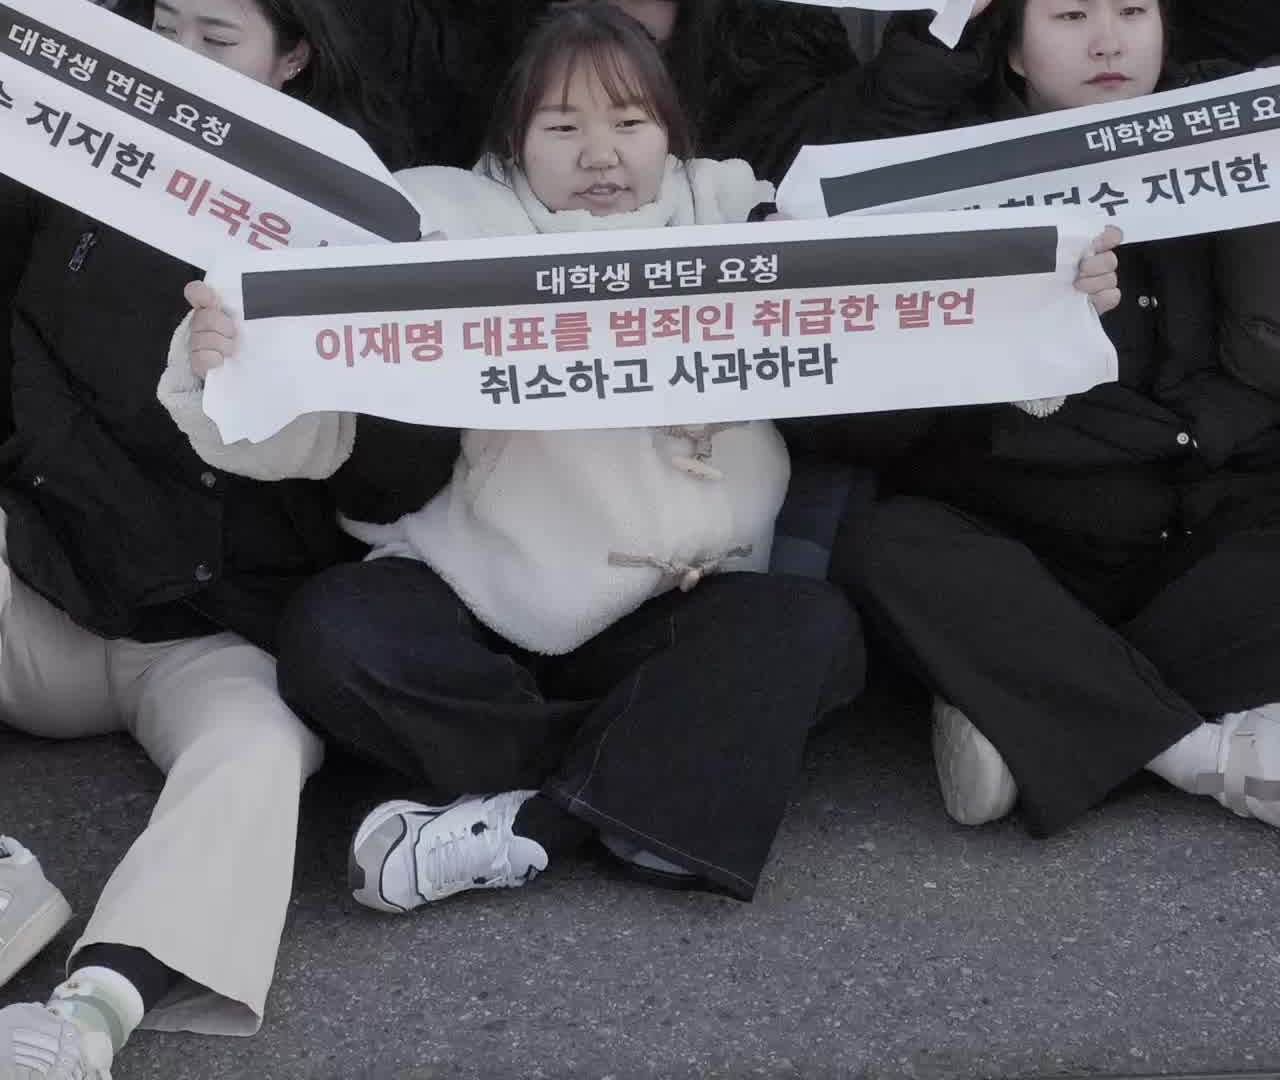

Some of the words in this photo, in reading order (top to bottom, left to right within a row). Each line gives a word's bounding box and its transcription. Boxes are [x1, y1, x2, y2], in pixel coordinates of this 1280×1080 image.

[7, 23, 100, 79] 대학생
[104, 68, 165, 116] 면담
[168, 103, 231, 147] 요청
[1085, 111, 1177, 154] 대학생
[1182, 100, 1241, 141] 면담
[26, 99, 157, 190] 지지한
[165, 169, 292, 251] 미국은
[1142, 153, 1269, 208] 지지한
[534, 262, 634, 296] 대학생
[641, 258, 707, 291] 면담
[716, 253, 781, 287] 요청
[314, 321, 444, 370] 이재명
[462, 311, 592, 360] 대표를
[609, 304, 736, 350] 범죄인
[751, 295, 879, 342] 취급한
[892, 288, 977, 329] 발언
[479, 356, 655, 406] 취소하고
[668, 344, 839, 393] 사과하라
